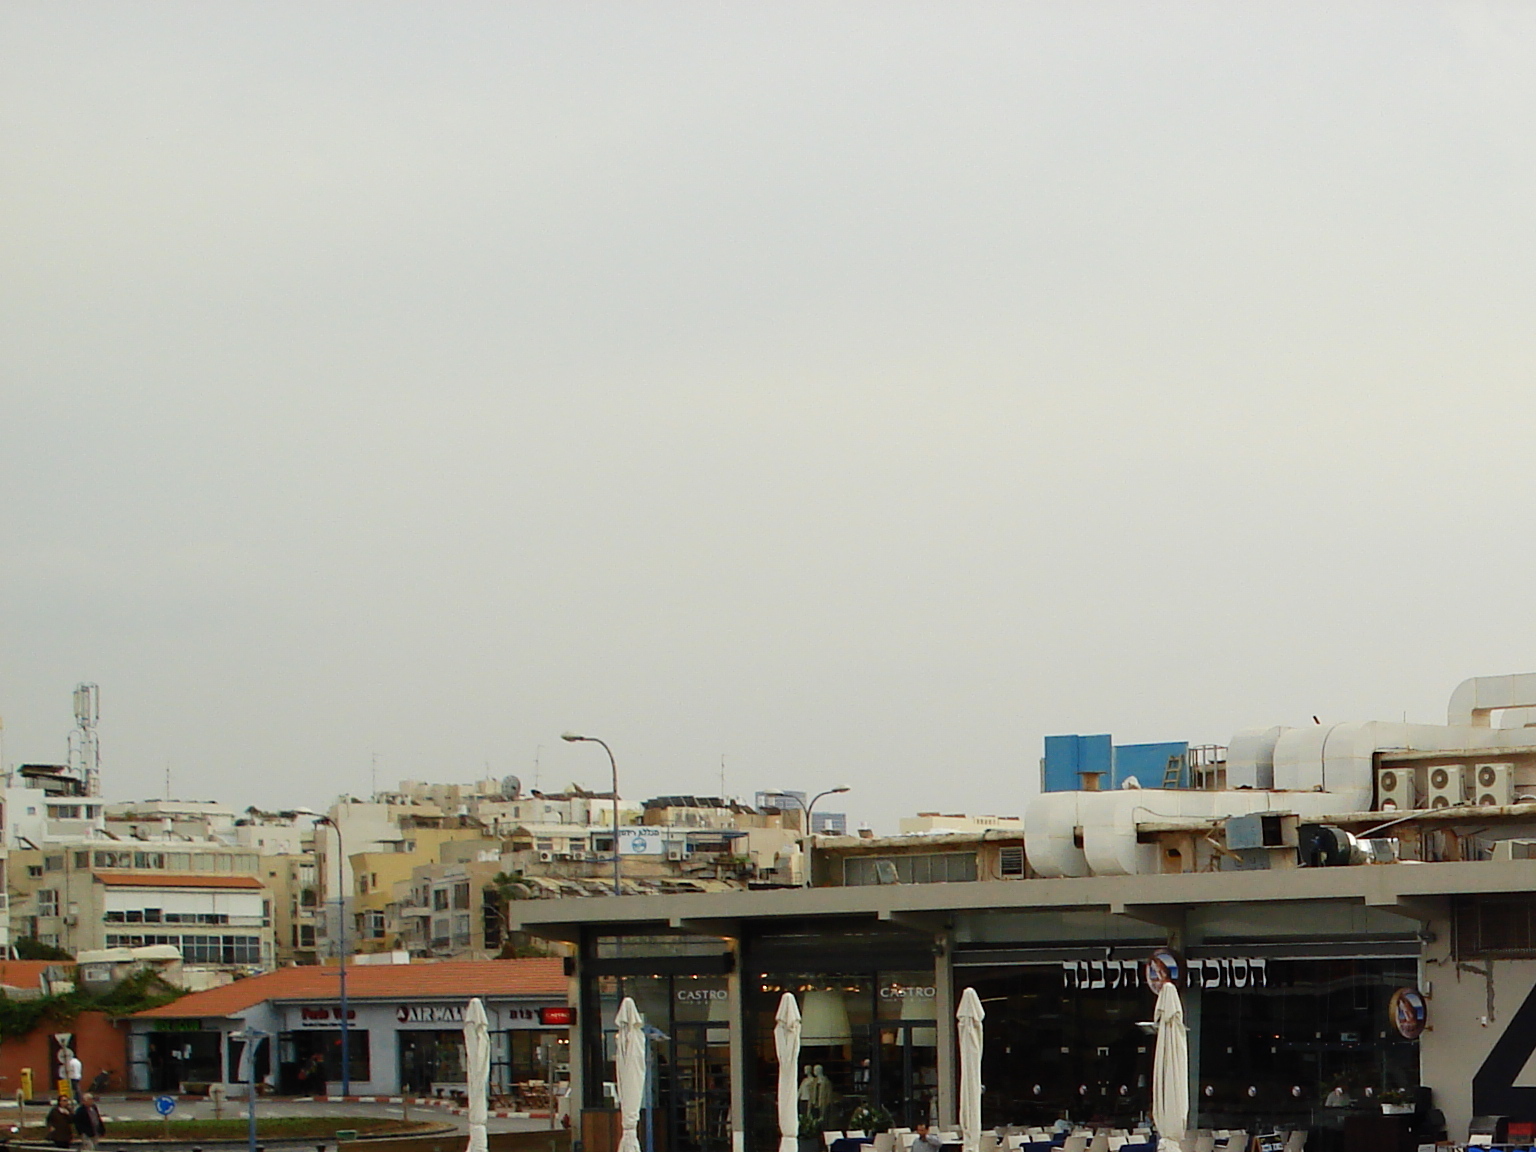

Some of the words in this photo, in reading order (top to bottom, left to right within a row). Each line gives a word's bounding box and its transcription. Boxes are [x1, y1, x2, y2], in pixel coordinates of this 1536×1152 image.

[1062, 947, 1139, 989] הלבנה
[1186, 958, 1267, 988] הסוכה
[677, 990, 728, 1000] CASTRO
[880, 987, 936, 998] CASTRO
